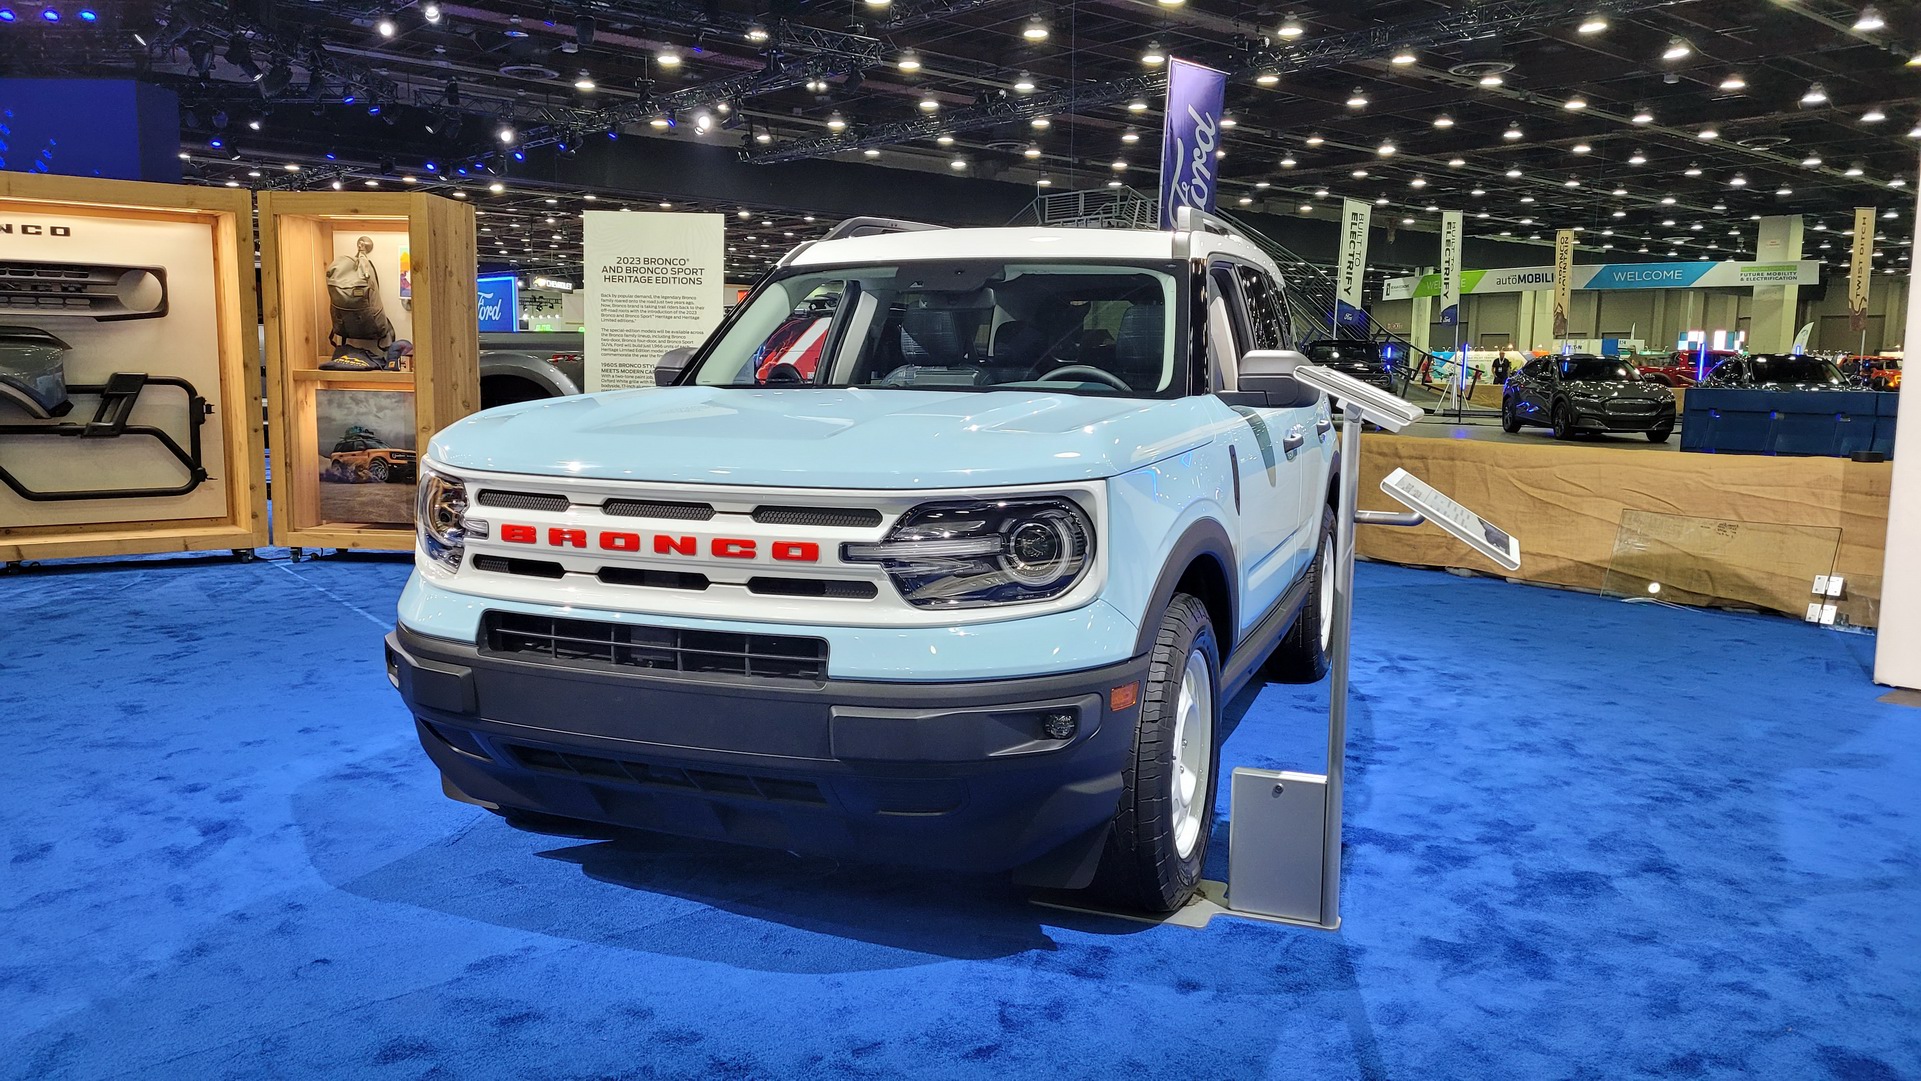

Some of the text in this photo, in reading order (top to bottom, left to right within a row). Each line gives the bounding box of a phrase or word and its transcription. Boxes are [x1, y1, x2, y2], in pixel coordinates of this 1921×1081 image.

[1168, 103, 1216, 230] Ford
[0, 224, 70, 236] NCO
[1354, 213, 1364, 267] BUILT TO
[616, 256, 641, 264] 2023
[1343, 212, 1358, 296] ELECTRIFY
[1442, 222, 1452, 300] ELECTRIFY
[601, 266, 705, 276] AND BRONCO SPORT
[604, 275, 703, 285] HERITAGE EDITIONS
[1426, 278, 1466, 290] WELE
[1613, 269, 1683, 281] WELCOME
[1856, 260, 1864, 298] TWIST
[478, 292, 502, 320] Ford
[500, 523, 819, 562] BRONCO
